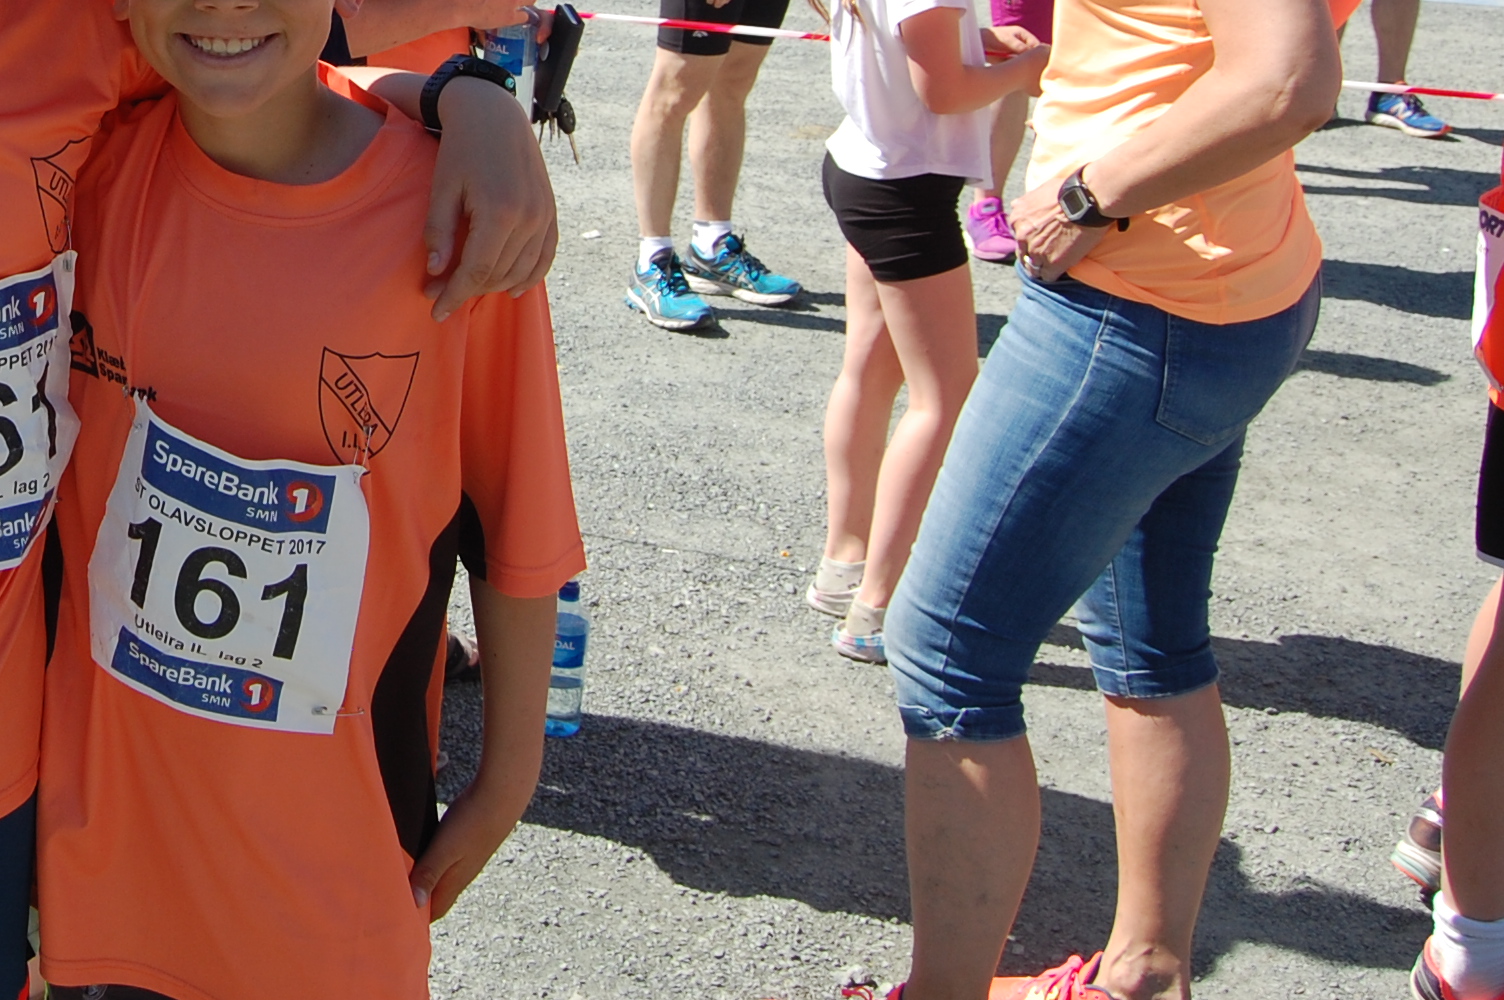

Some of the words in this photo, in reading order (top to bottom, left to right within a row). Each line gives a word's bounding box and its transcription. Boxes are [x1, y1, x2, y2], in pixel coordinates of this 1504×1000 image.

[0, 321, 25, 340] SMN
[13, 478, 38, 496] lag
[152, 440, 279, 506] SpareBank
[135, 477, 147, 499] ST
[148, 494, 286, 555] OLAVSLOPPET
[289, 539, 327, 556] 2017
[246, 507, 279, 522] SMN
[13, 536, 29, 549] SM
[127, 516, 308, 660] 161
[134, 613, 185, 651] Utleira
[191, 643, 208, 656] IL
[218, 651, 247, 666] lag
[252, 658, 264, 668] 2
[128, 642, 234, 694] SpareBank
[201, 693, 232, 708] SMN
